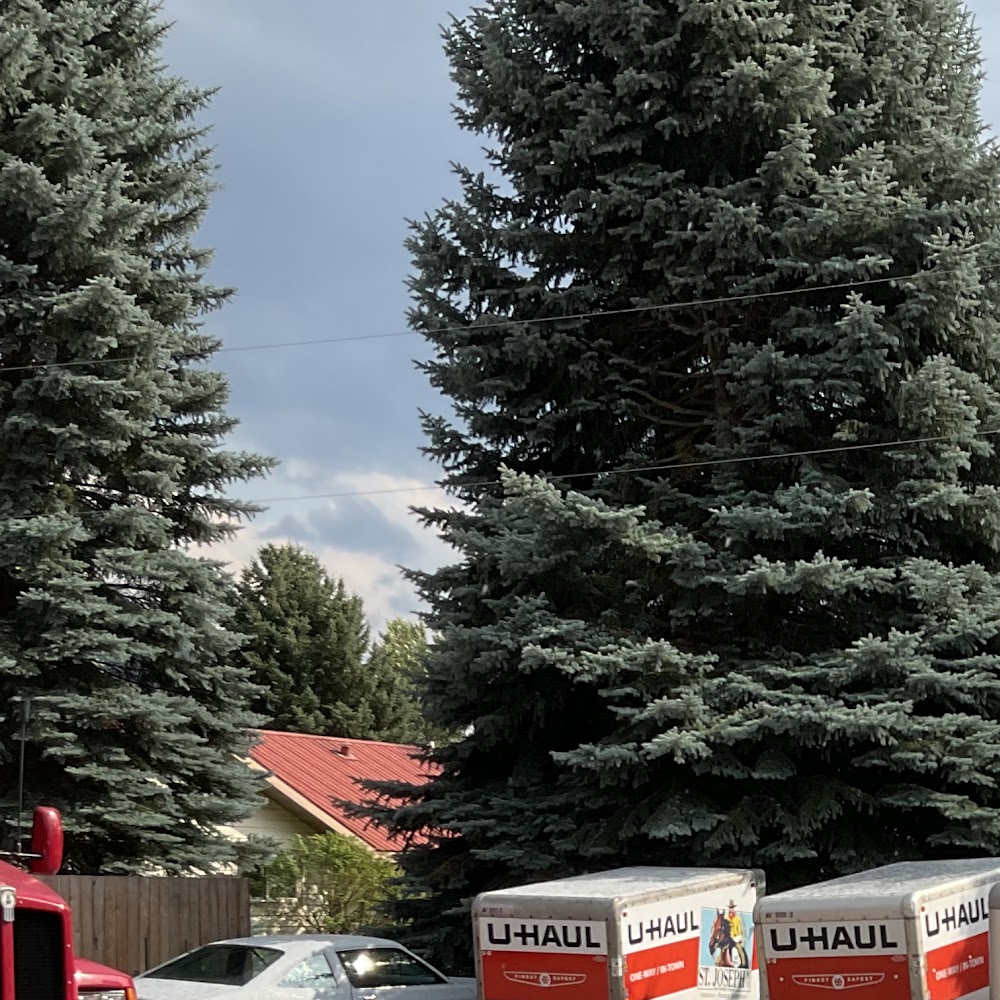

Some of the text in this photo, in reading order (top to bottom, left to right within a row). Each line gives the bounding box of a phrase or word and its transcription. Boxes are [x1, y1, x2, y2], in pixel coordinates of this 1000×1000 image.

[628, 910, 700, 945] U-HAUL
[925, 897, 989, 938] U-HAUL
[487, 923, 601, 948] U-HAUL
[769, 924, 898, 951] U-HAUL
[629, 967, 656, 982] ONE-WAY
[699, 967, 711, 987] ST.
